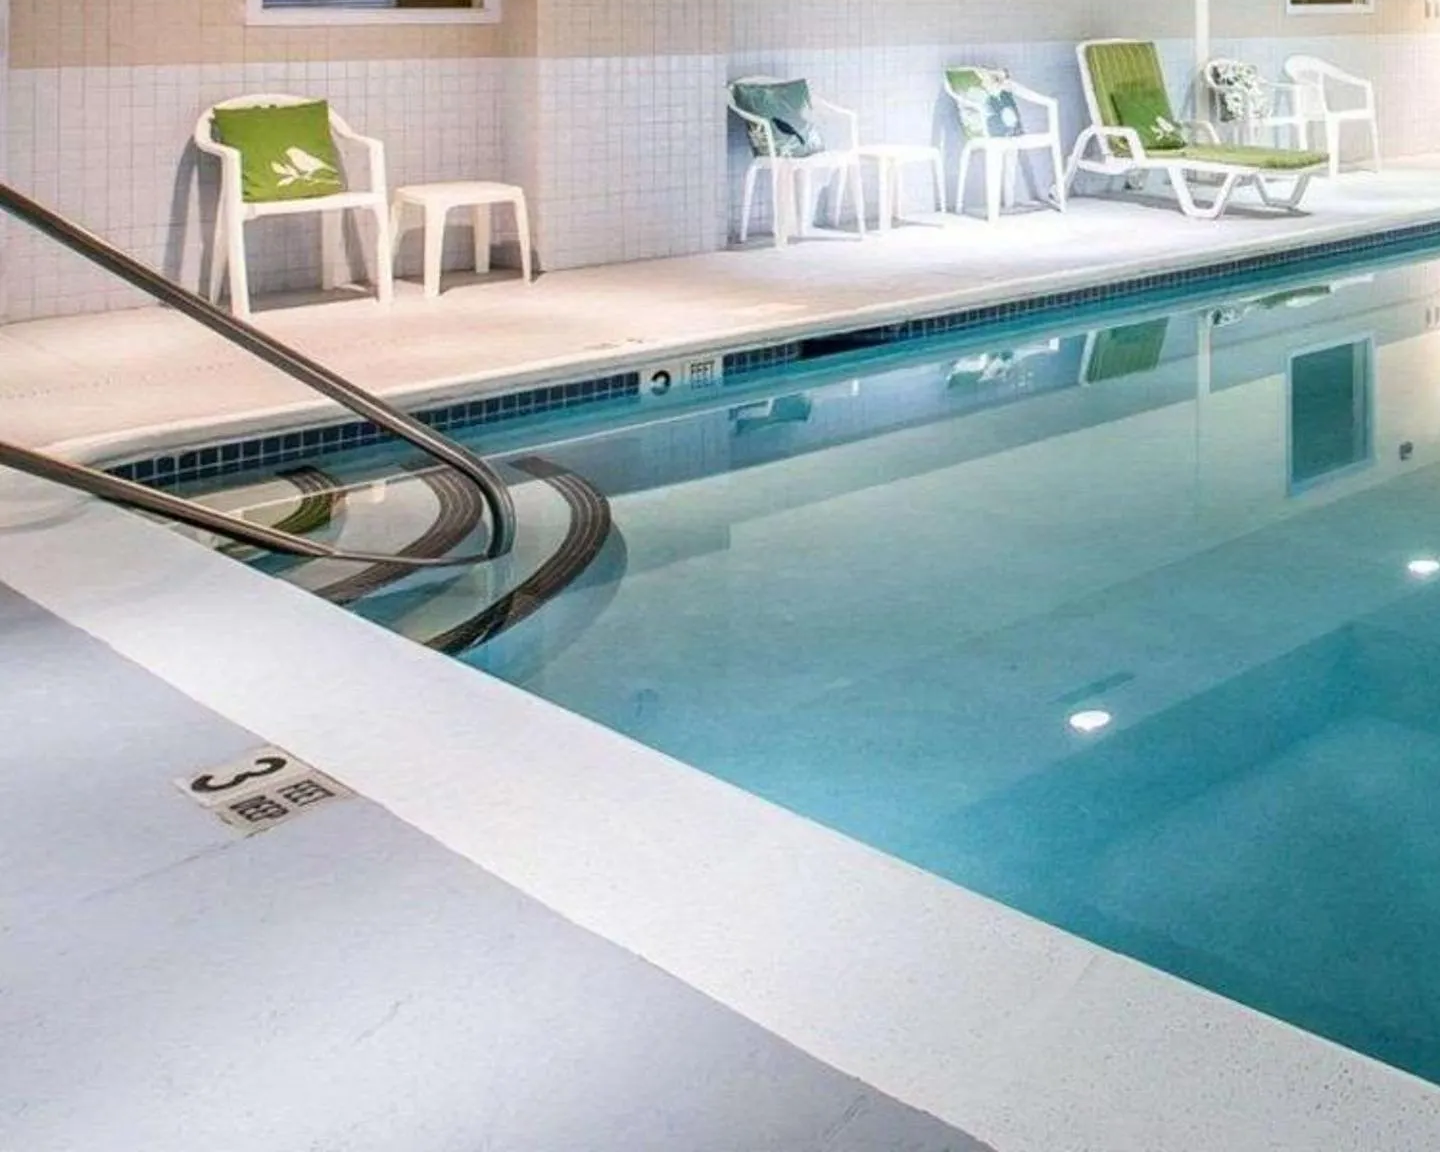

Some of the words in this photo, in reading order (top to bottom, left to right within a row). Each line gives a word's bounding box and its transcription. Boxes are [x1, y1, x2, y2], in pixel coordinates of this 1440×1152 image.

[190, 756, 289, 794] 3
[276, 778, 337, 808] FEET
[228, 794, 291, 824] DEEP
